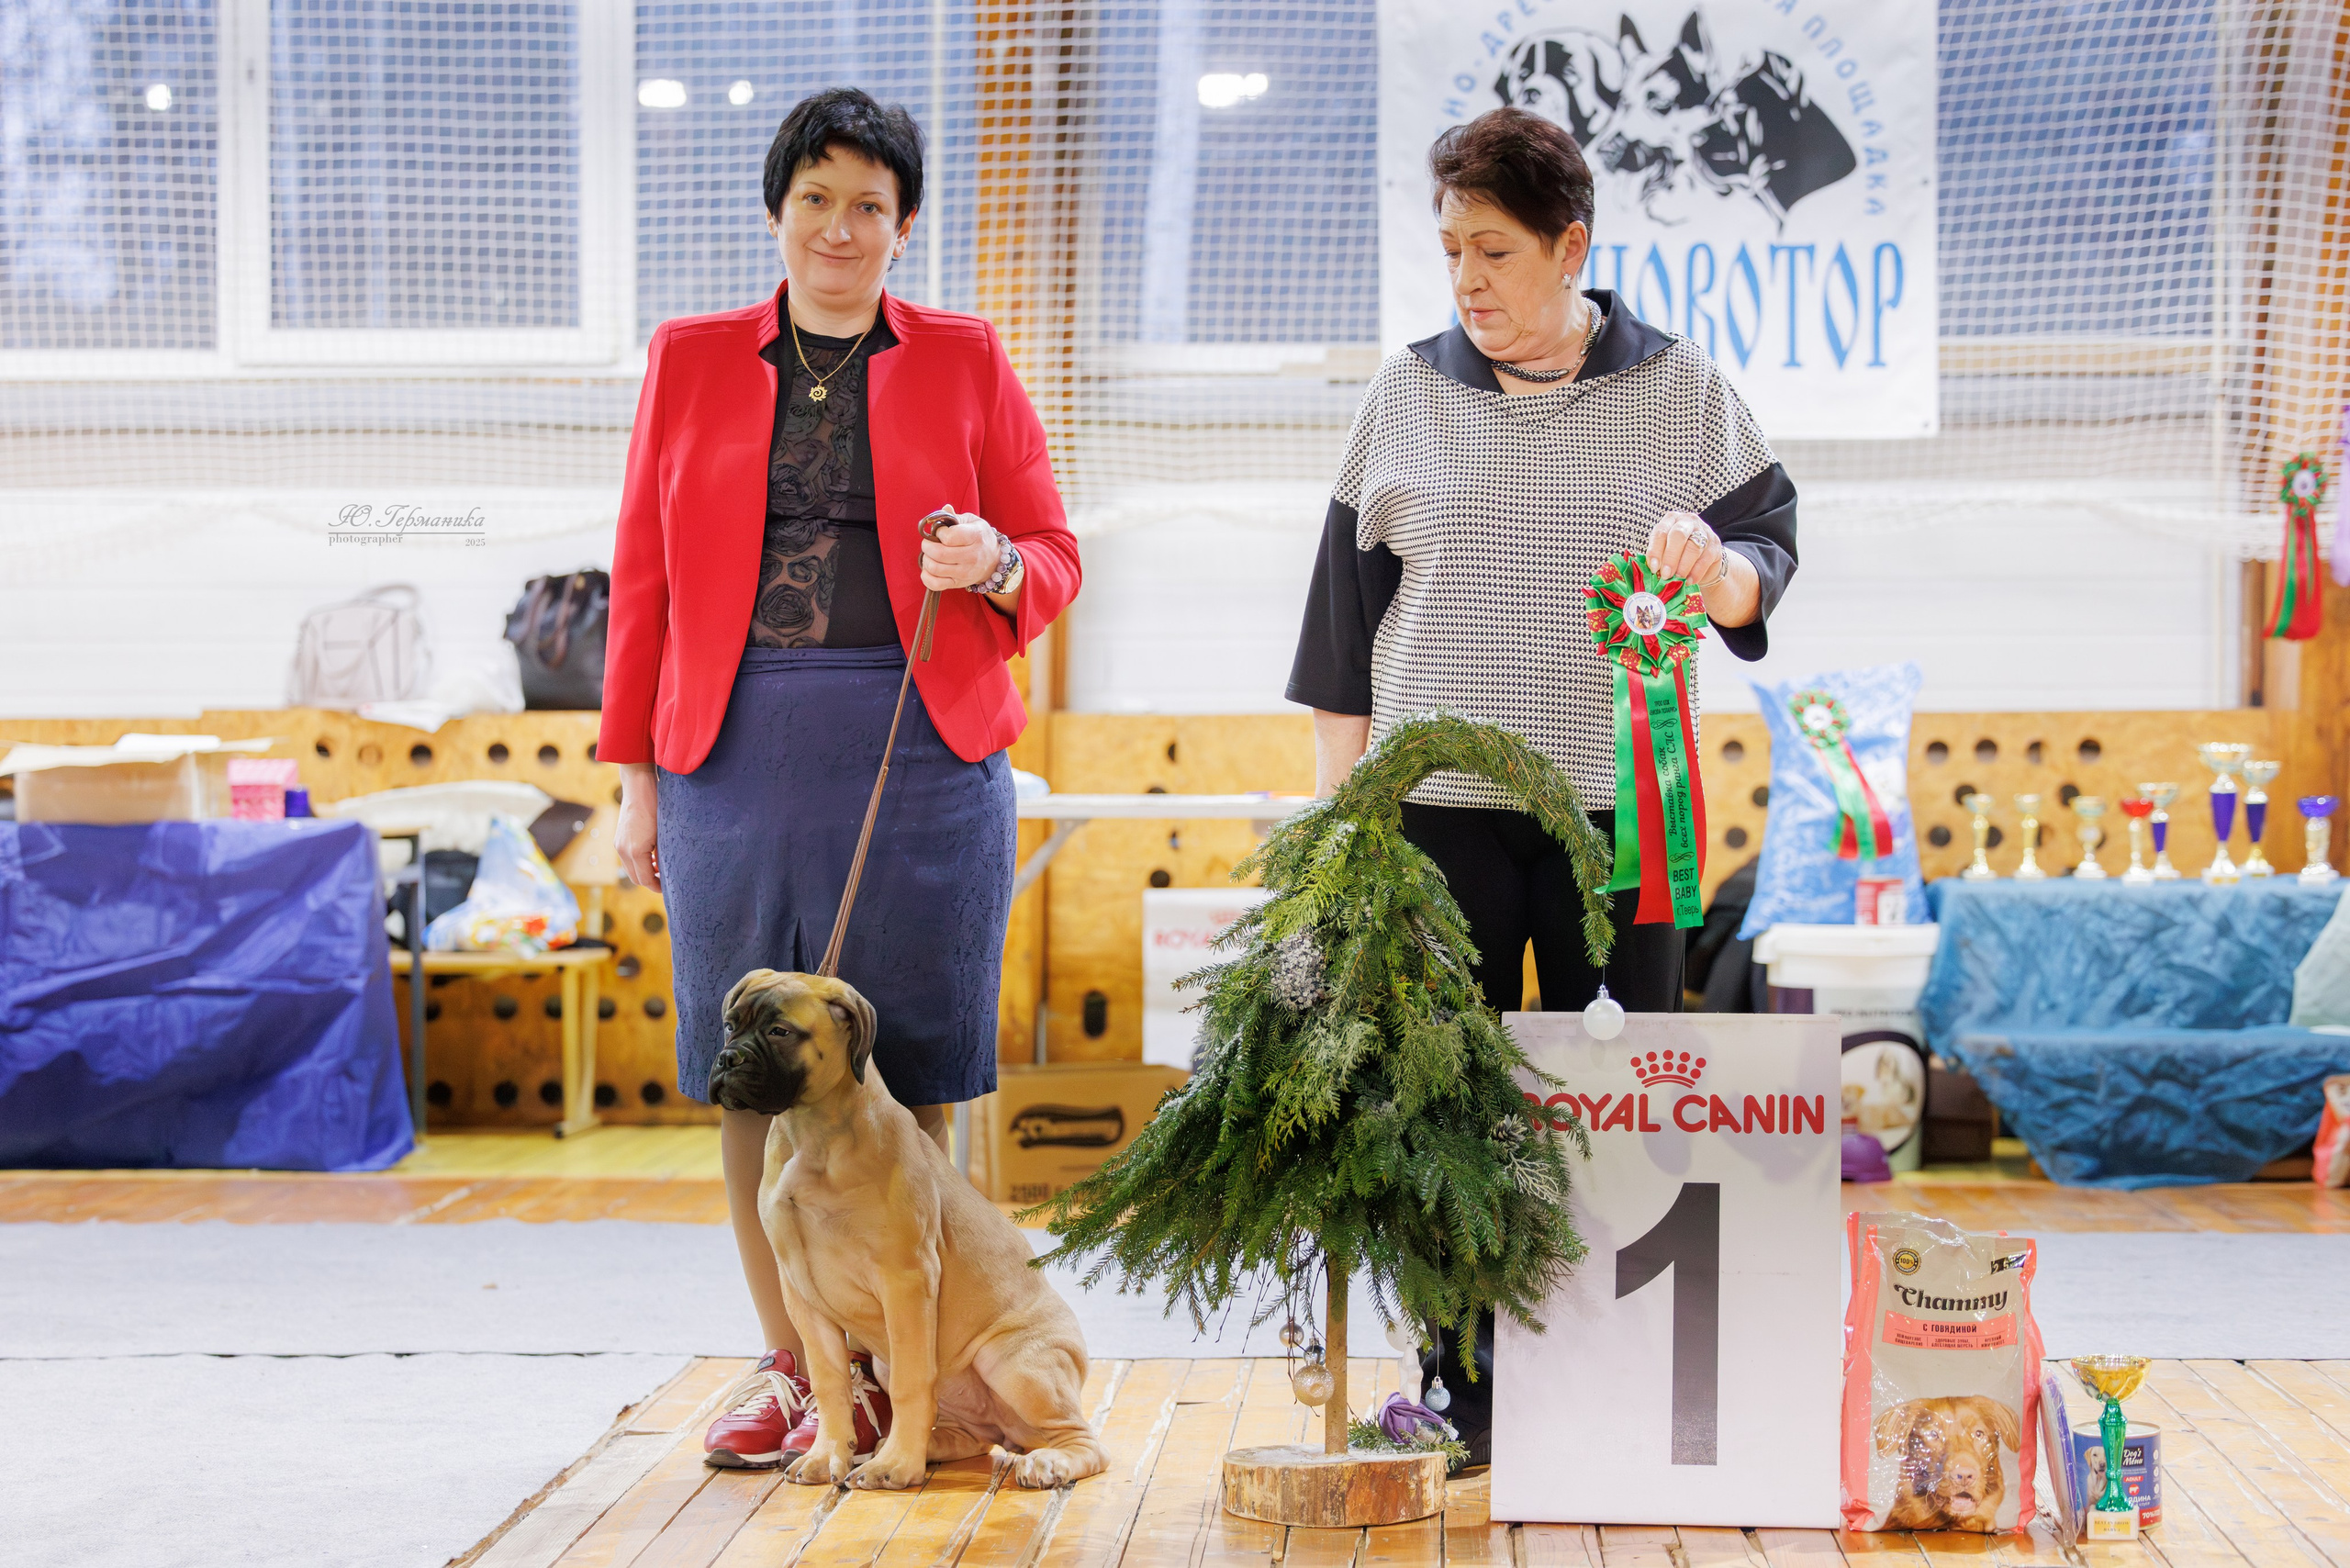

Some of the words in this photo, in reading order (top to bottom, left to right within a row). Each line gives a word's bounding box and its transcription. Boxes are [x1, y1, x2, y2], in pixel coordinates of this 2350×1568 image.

[1801, 14, 1890, 216] ПЛОЩАДКА
[1658, 746, 1670, 777] собак
[1671, 756, 1686, 789] ранга
[1664, 779, 1678, 837] Выставка
[1676, 790, 1688, 823] пород
[1680, 826, 1690, 848] всех
[1673, 868, 1695, 882] BEST
[1674, 885, 1697, 900] BABY
[1672, 1092, 1825, 1135] CANIN
[1893, 1283, 2009, 1311] Chammy
[1615, 1182, 1721, 1466] 1
[1922, 1323, 1928, 1331] С
[1931, 1324, 1977, 1335] ГОВЯДИНОЙ
[2122, 1457, 2143, 1466] Menu
[2123, 1448, 2142, 1460] Dog's
[2128, 1495, 2152, 1504] ЯДИНА
